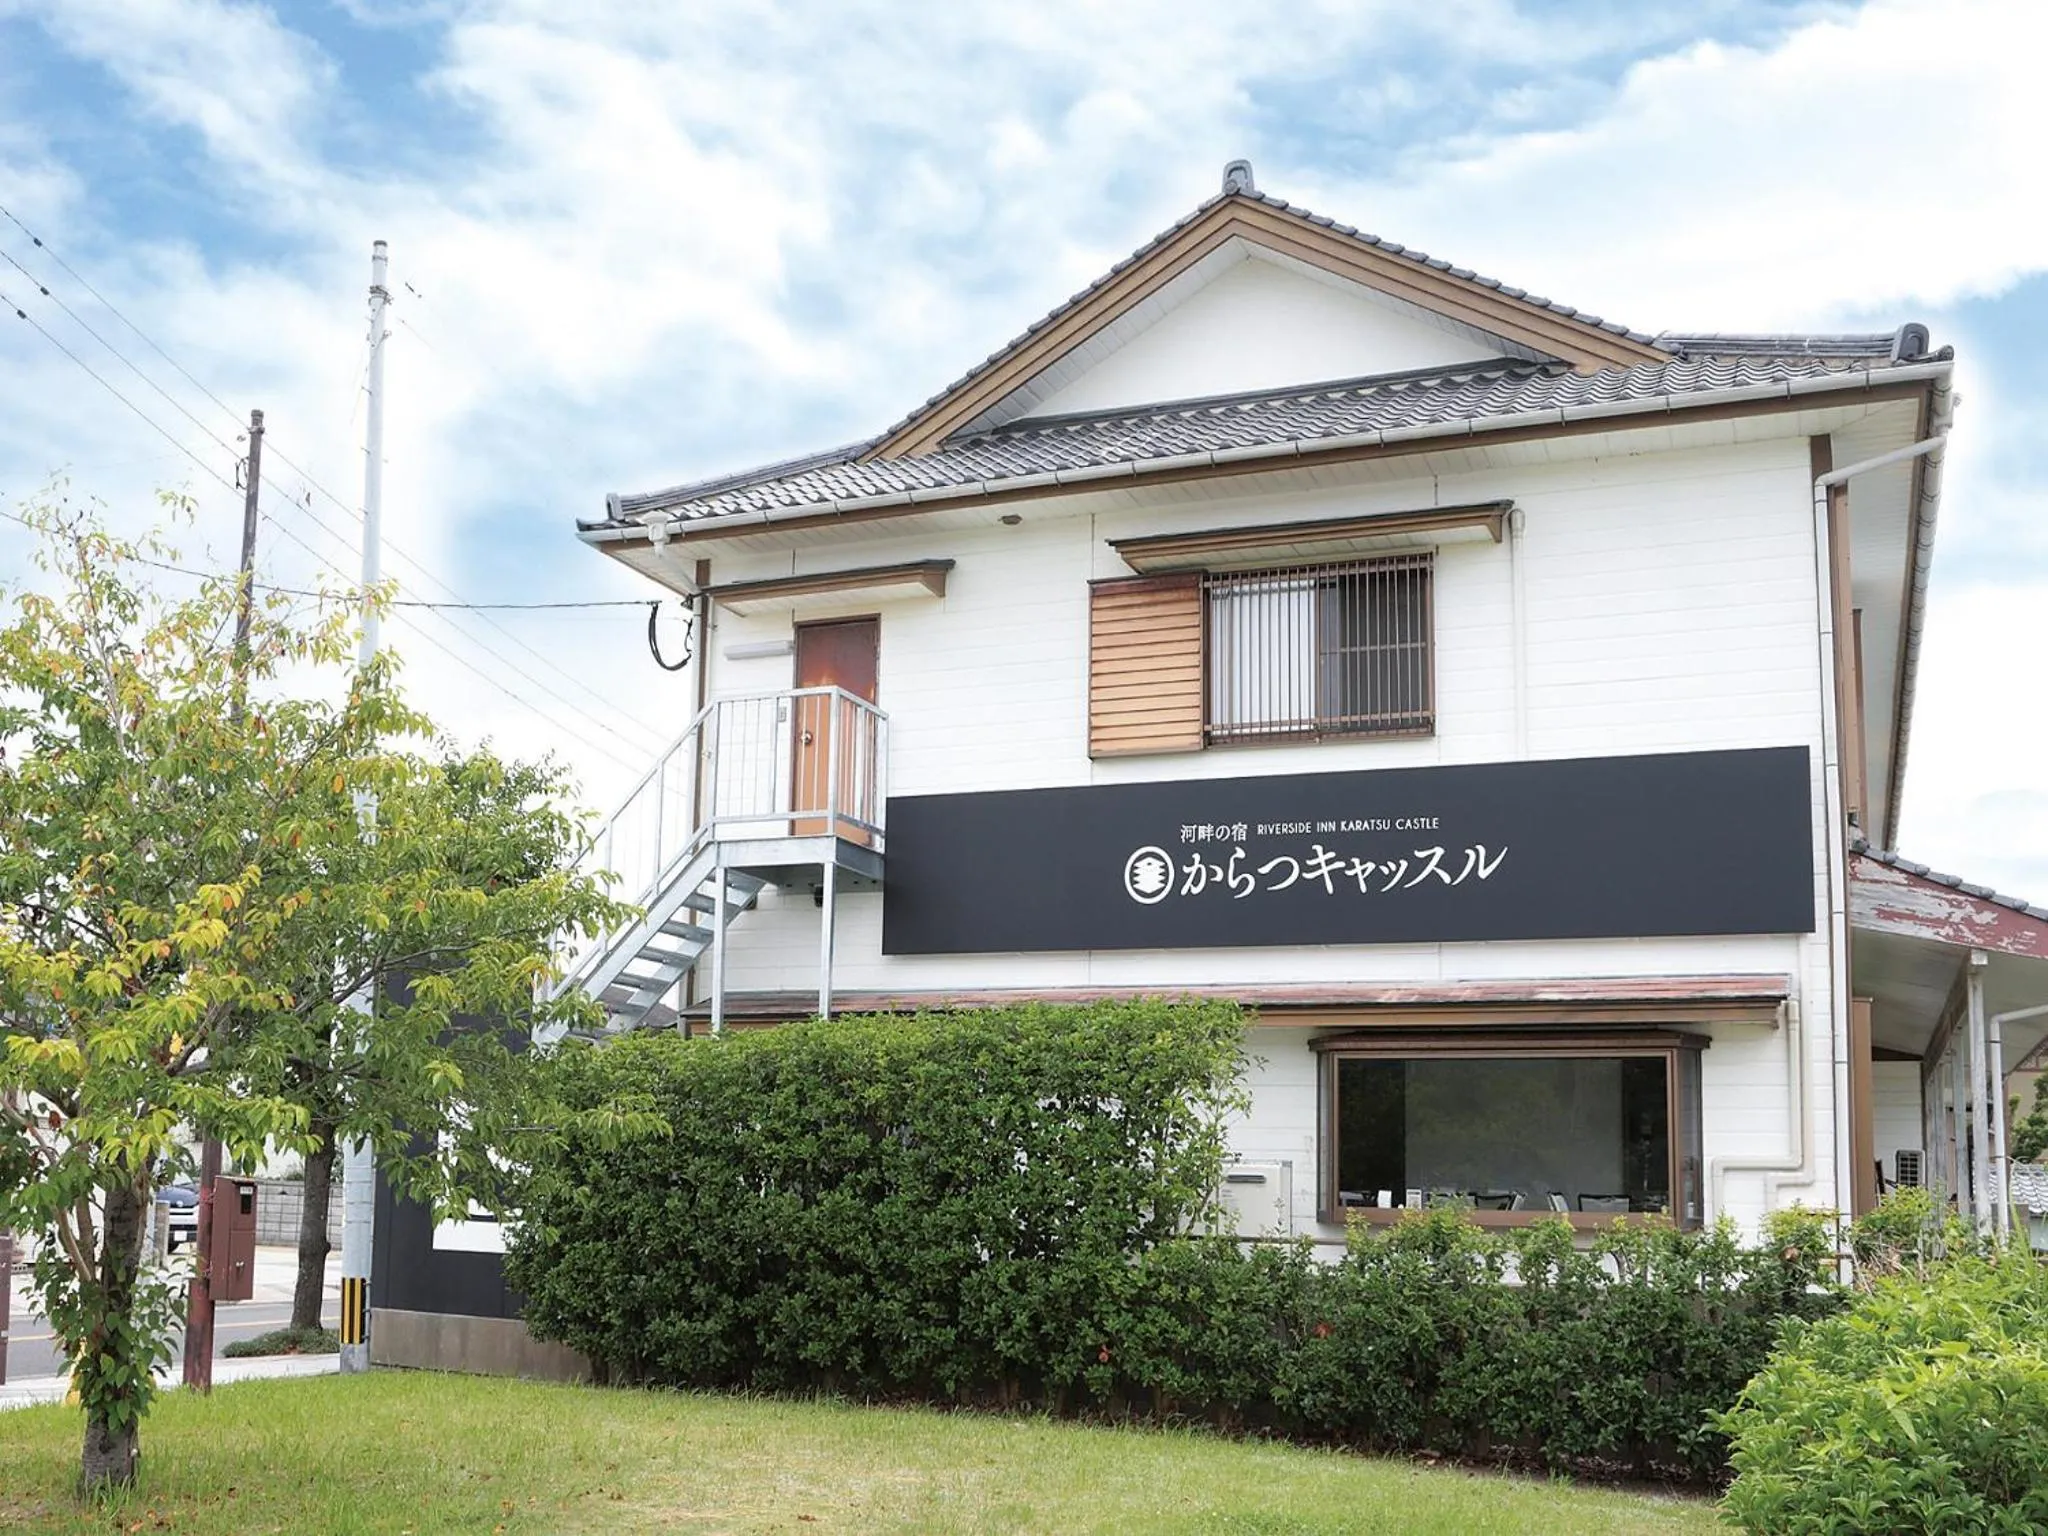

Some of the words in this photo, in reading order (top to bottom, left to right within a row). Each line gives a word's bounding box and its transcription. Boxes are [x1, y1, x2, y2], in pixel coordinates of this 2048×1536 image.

[1180, 822, 1248, 843] 河畔の宿
[1257, 822, 1312, 835] RIVERSIDE
[1316, 821, 1336, 833] INN
[1340, 819, 1391, 832] KARATSU
[1395, 817, 1440, 830] CASTLE
[1180, 844, 1508, 899] からつキャッスル
